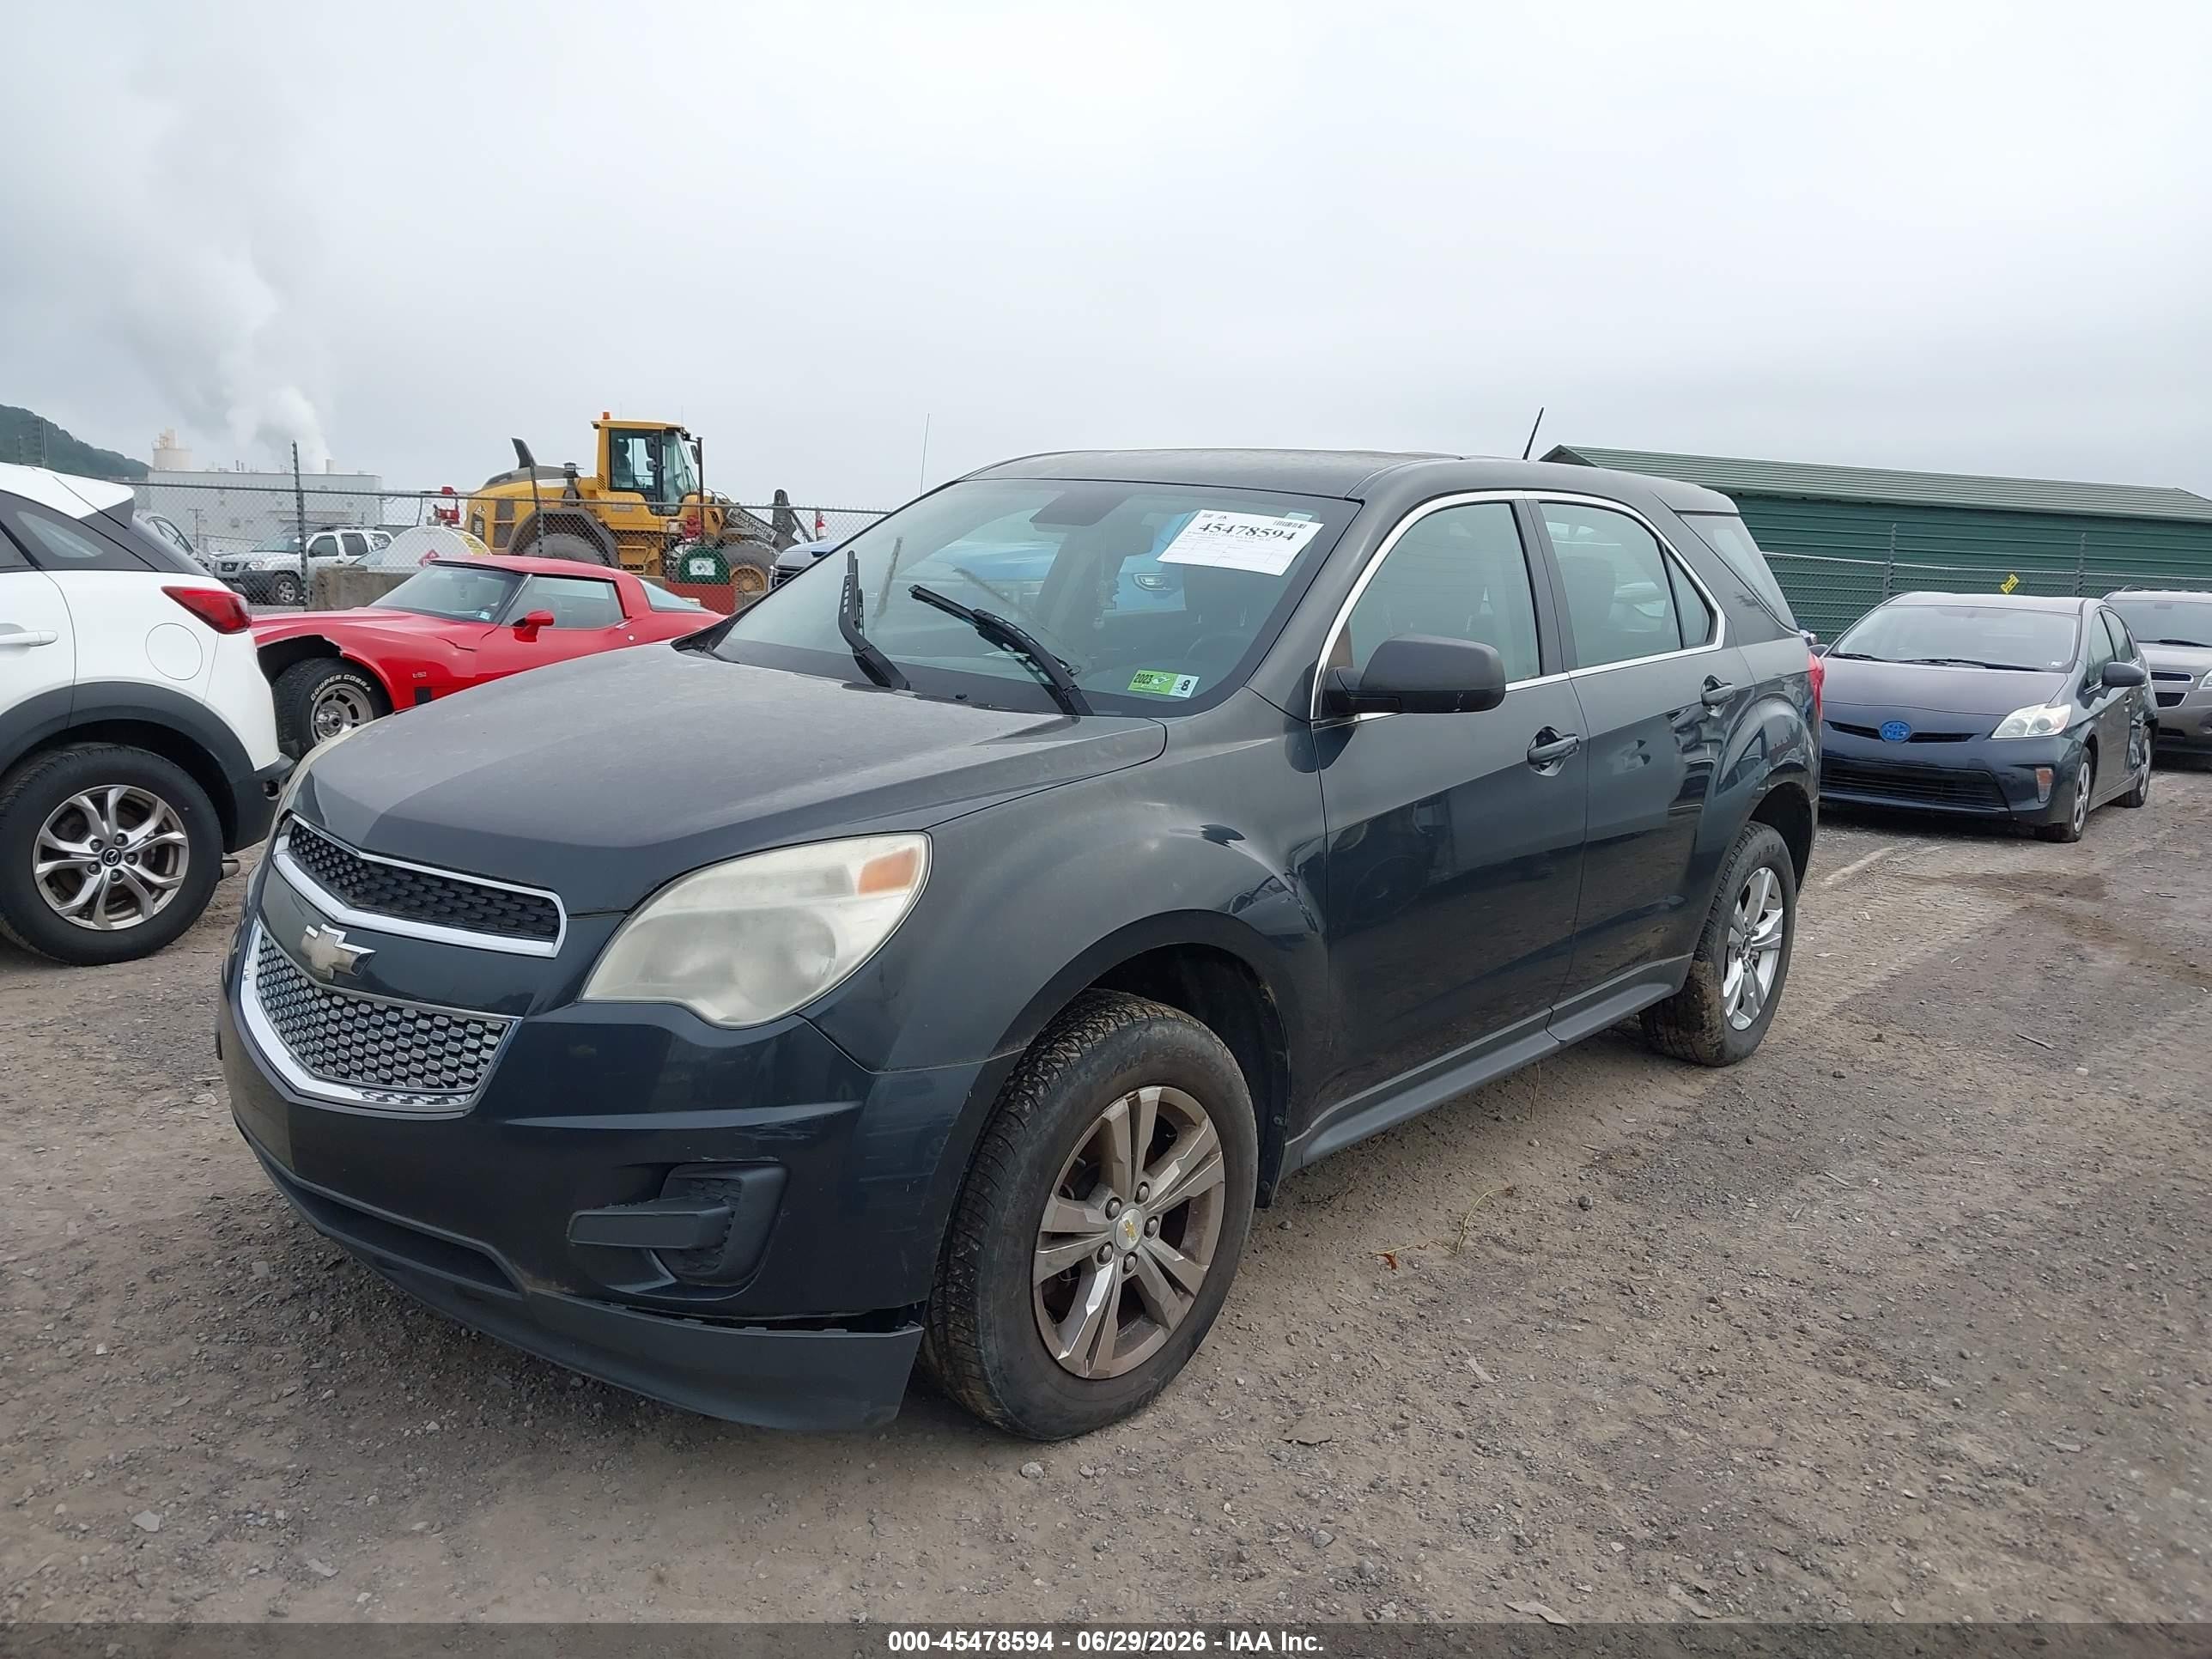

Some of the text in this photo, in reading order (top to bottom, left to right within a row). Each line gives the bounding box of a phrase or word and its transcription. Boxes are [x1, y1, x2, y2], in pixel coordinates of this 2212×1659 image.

[1199, 522, 1297, 541] 45478594
[1133, 673, 1154, 684] 2023
[1181, 679, 1191, 691] 8
[310, 674, 371, 702] COOPER COBRA
